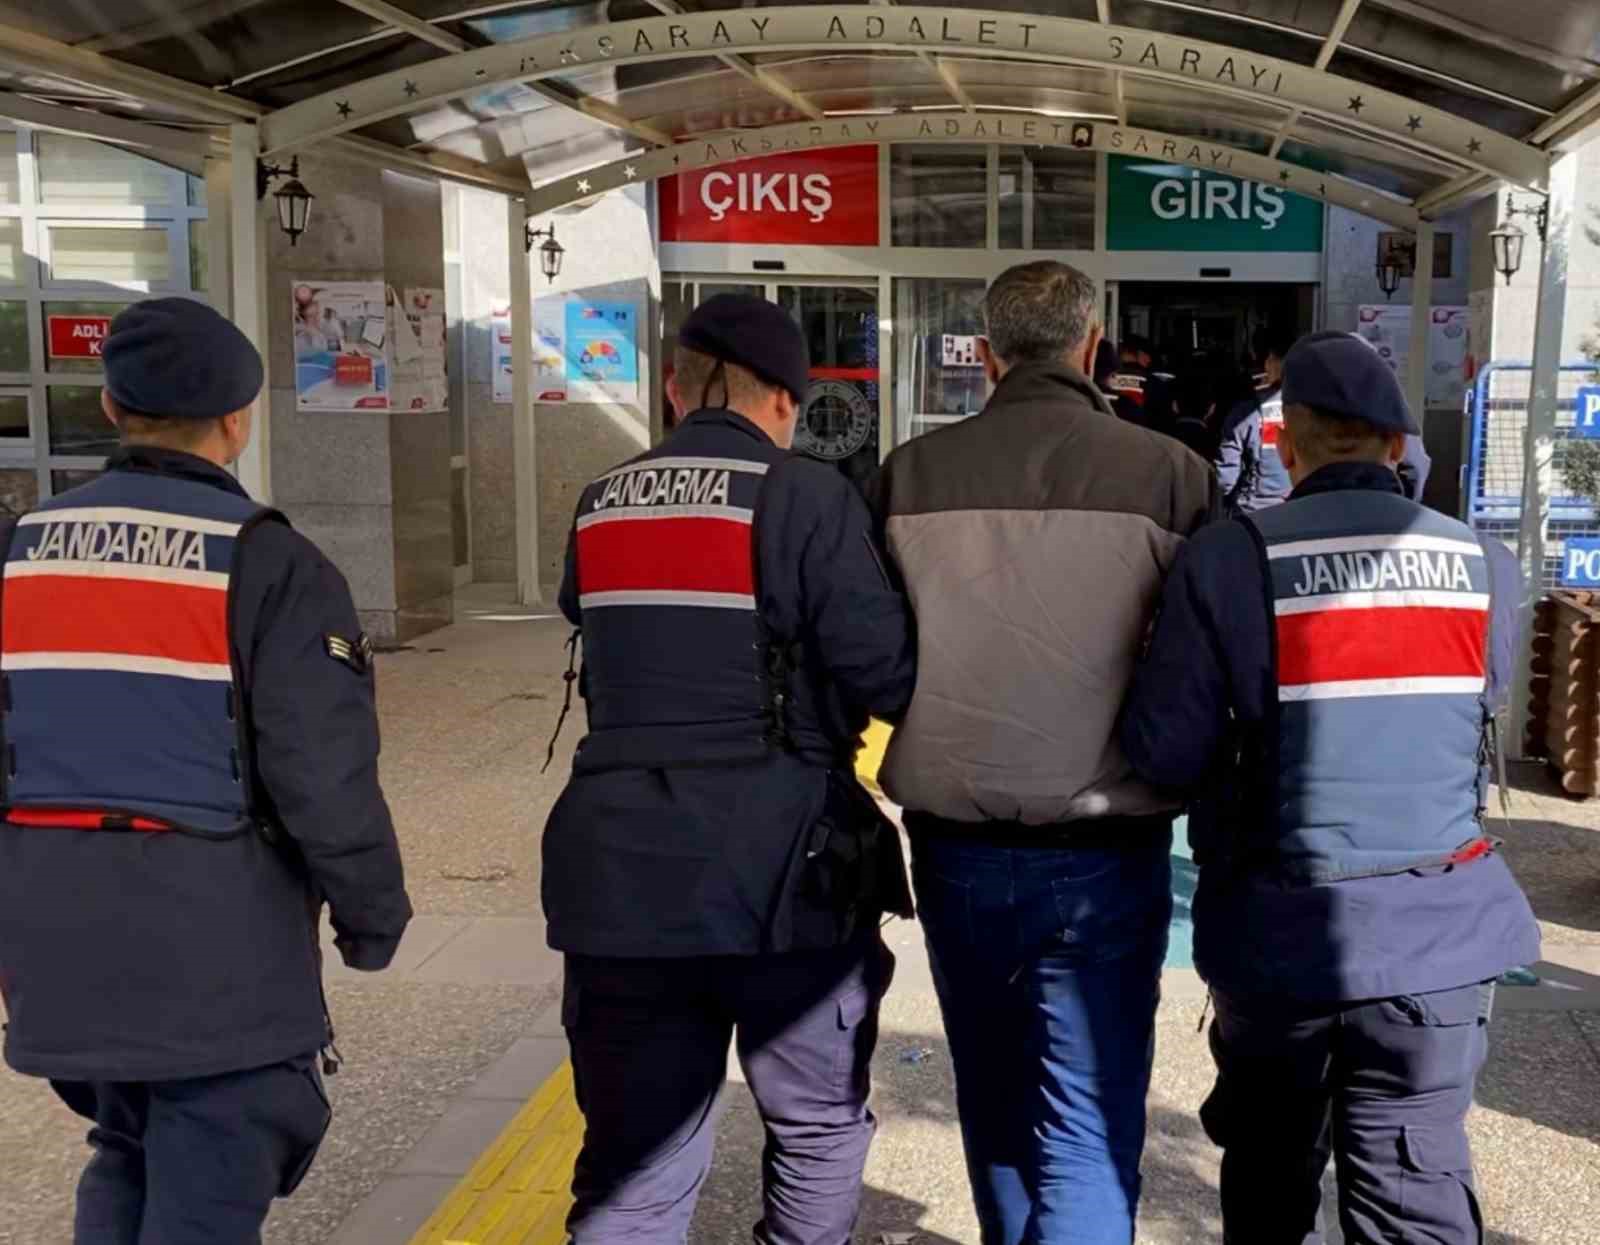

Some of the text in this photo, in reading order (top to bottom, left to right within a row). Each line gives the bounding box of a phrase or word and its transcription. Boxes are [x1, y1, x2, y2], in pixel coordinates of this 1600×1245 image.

[826, 15, 1038, 49] ADALET
[1108, 35, 1283, 94] SARAYI
[917, 118, 1063, 141] ADALET
[1109, 130, 1234, 169] SARAYI
[700, 171, 833, 223] ÇIKIŞ
[593, 469, 731, 510] JANDARMA
[27, 520, 207, 570] JANDARMA
[1294, 550, 1473, 595] JANDARMA
